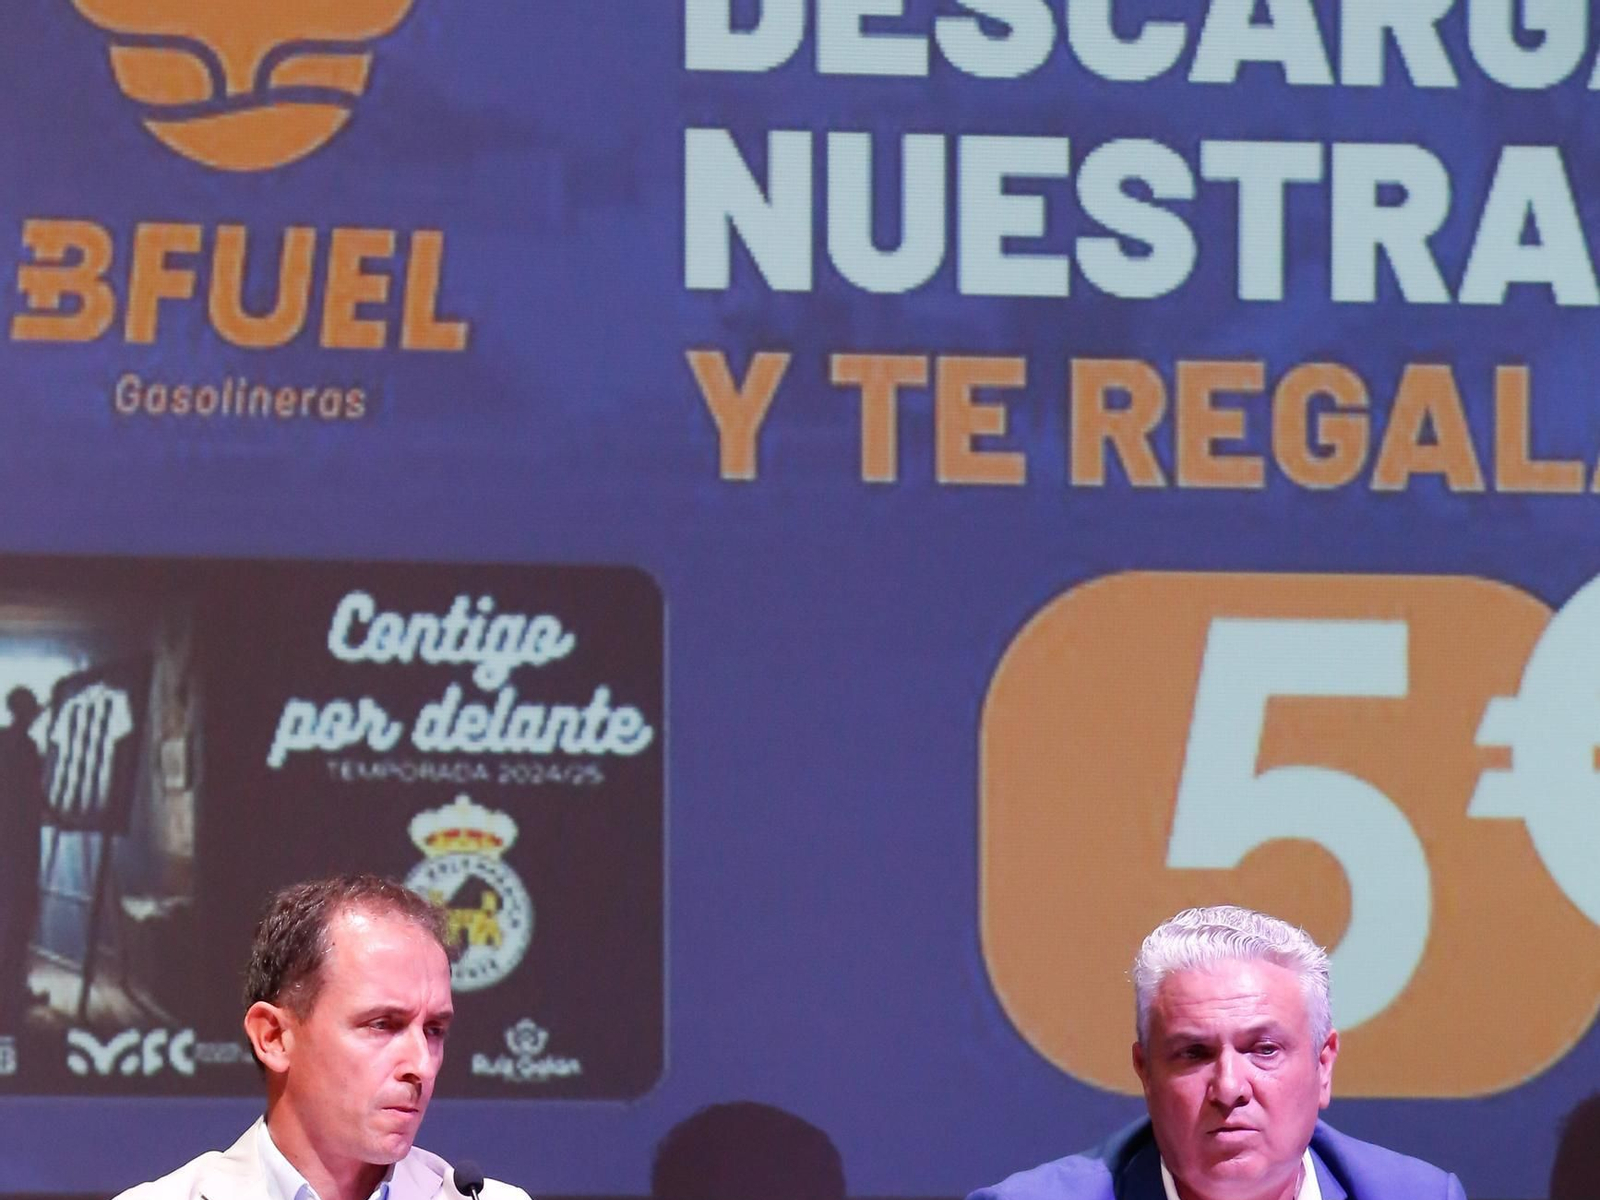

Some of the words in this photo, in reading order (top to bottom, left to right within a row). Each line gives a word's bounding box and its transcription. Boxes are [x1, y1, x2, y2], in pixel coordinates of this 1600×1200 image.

[685, 0, 1600, 89] DESCARG
[684, 128, 1600, 306] NUESTRA
[11, 219, 469, 352] BFUEL
[115, 373, 366, 421] Gasolineras
[686, 350, 791, 482] Y
[831, 354, 1027, 486] TE
[1070, 358, 1600, 494] REGAL
[328, 590, 576, 691] Contigo
[267, 696, 403, 768] por
[411, 682, 653, 755] delante
[327, 761, 489, 783] TEMPORADA
